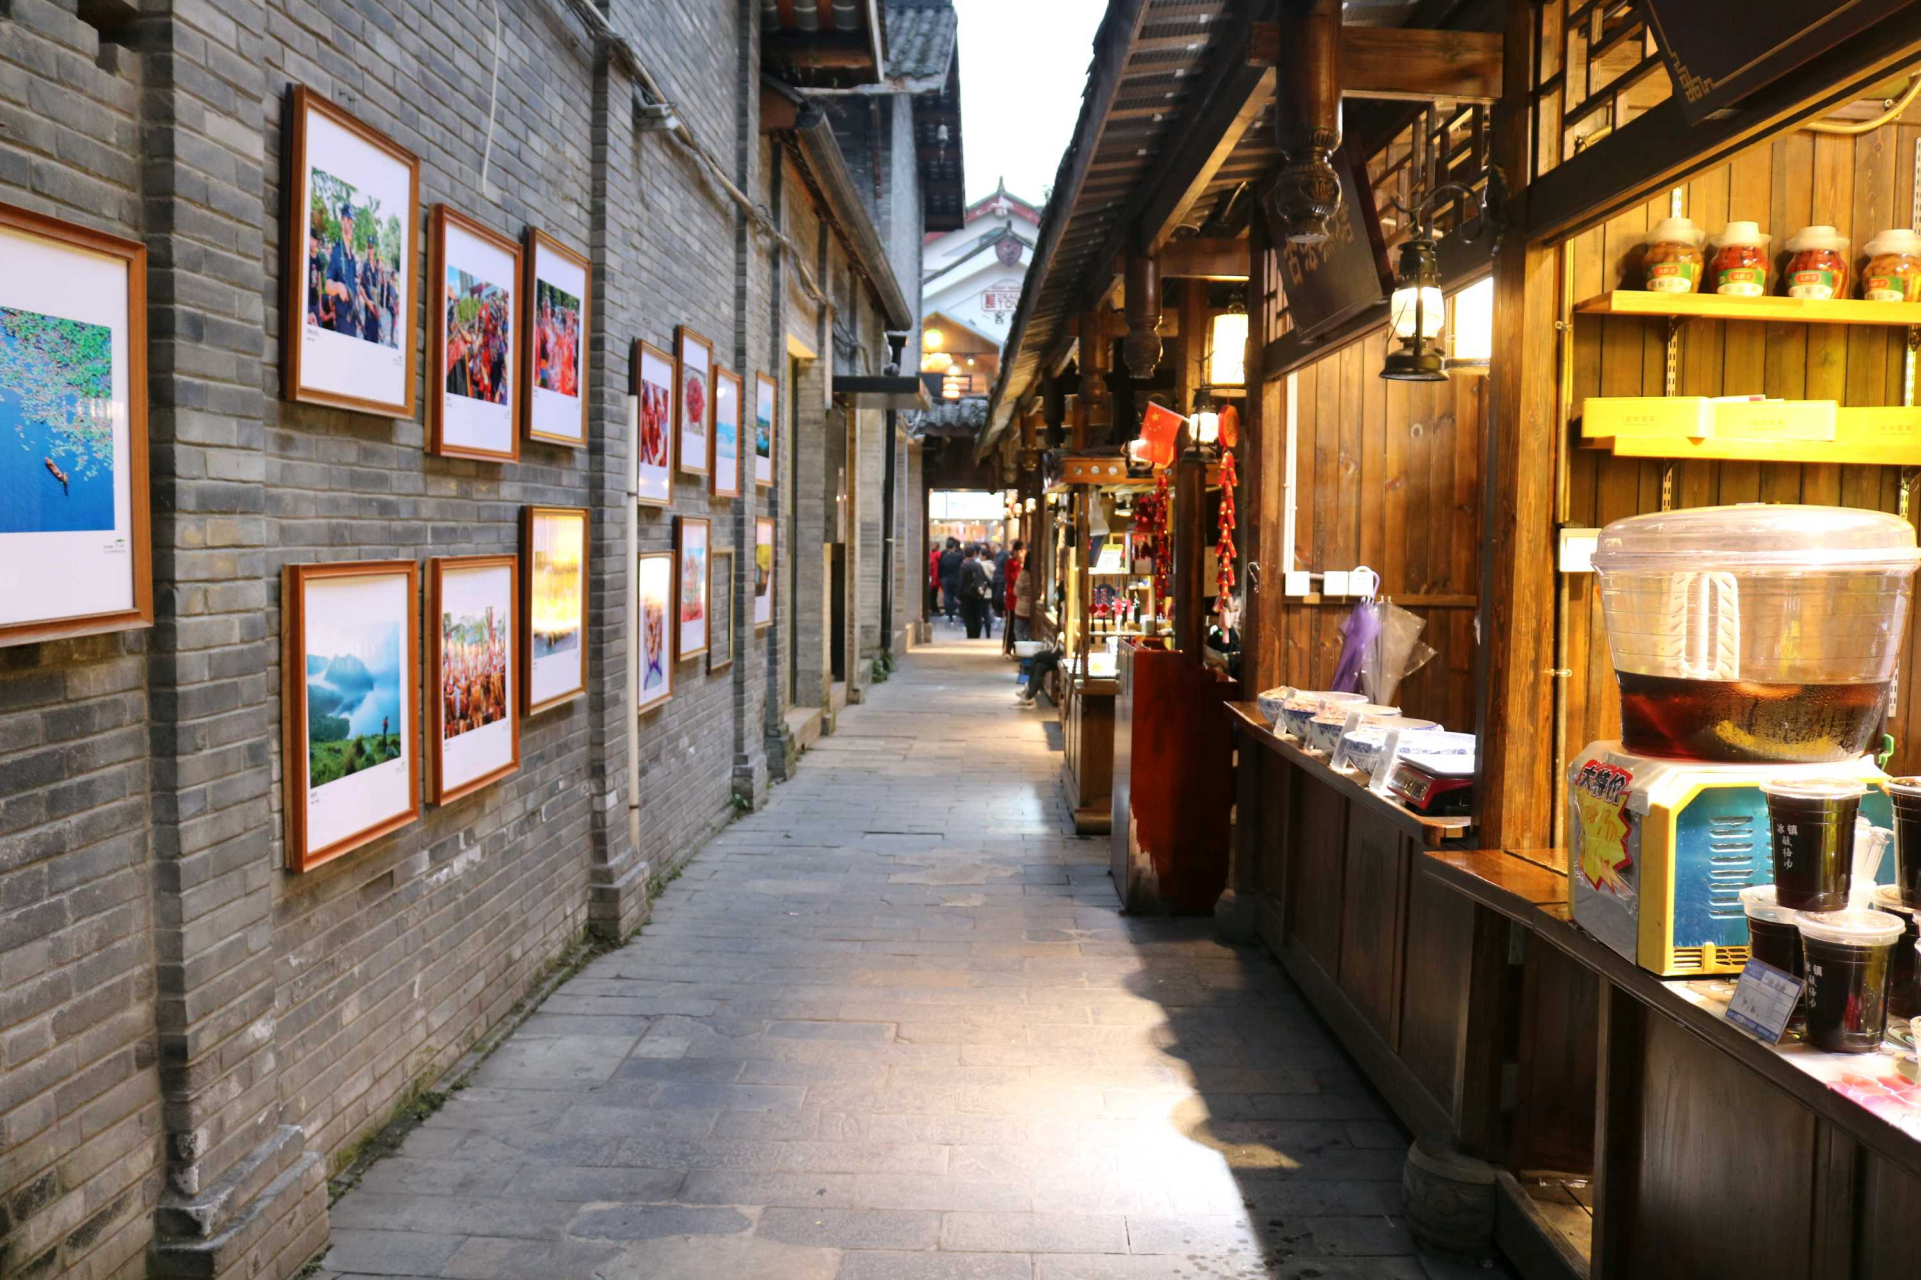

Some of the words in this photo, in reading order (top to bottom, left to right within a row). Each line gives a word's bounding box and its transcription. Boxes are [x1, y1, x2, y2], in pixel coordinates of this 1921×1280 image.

[1578, 765, 1627, 806] 大特价
[1776, 823, 1798, 836] 冰镇
